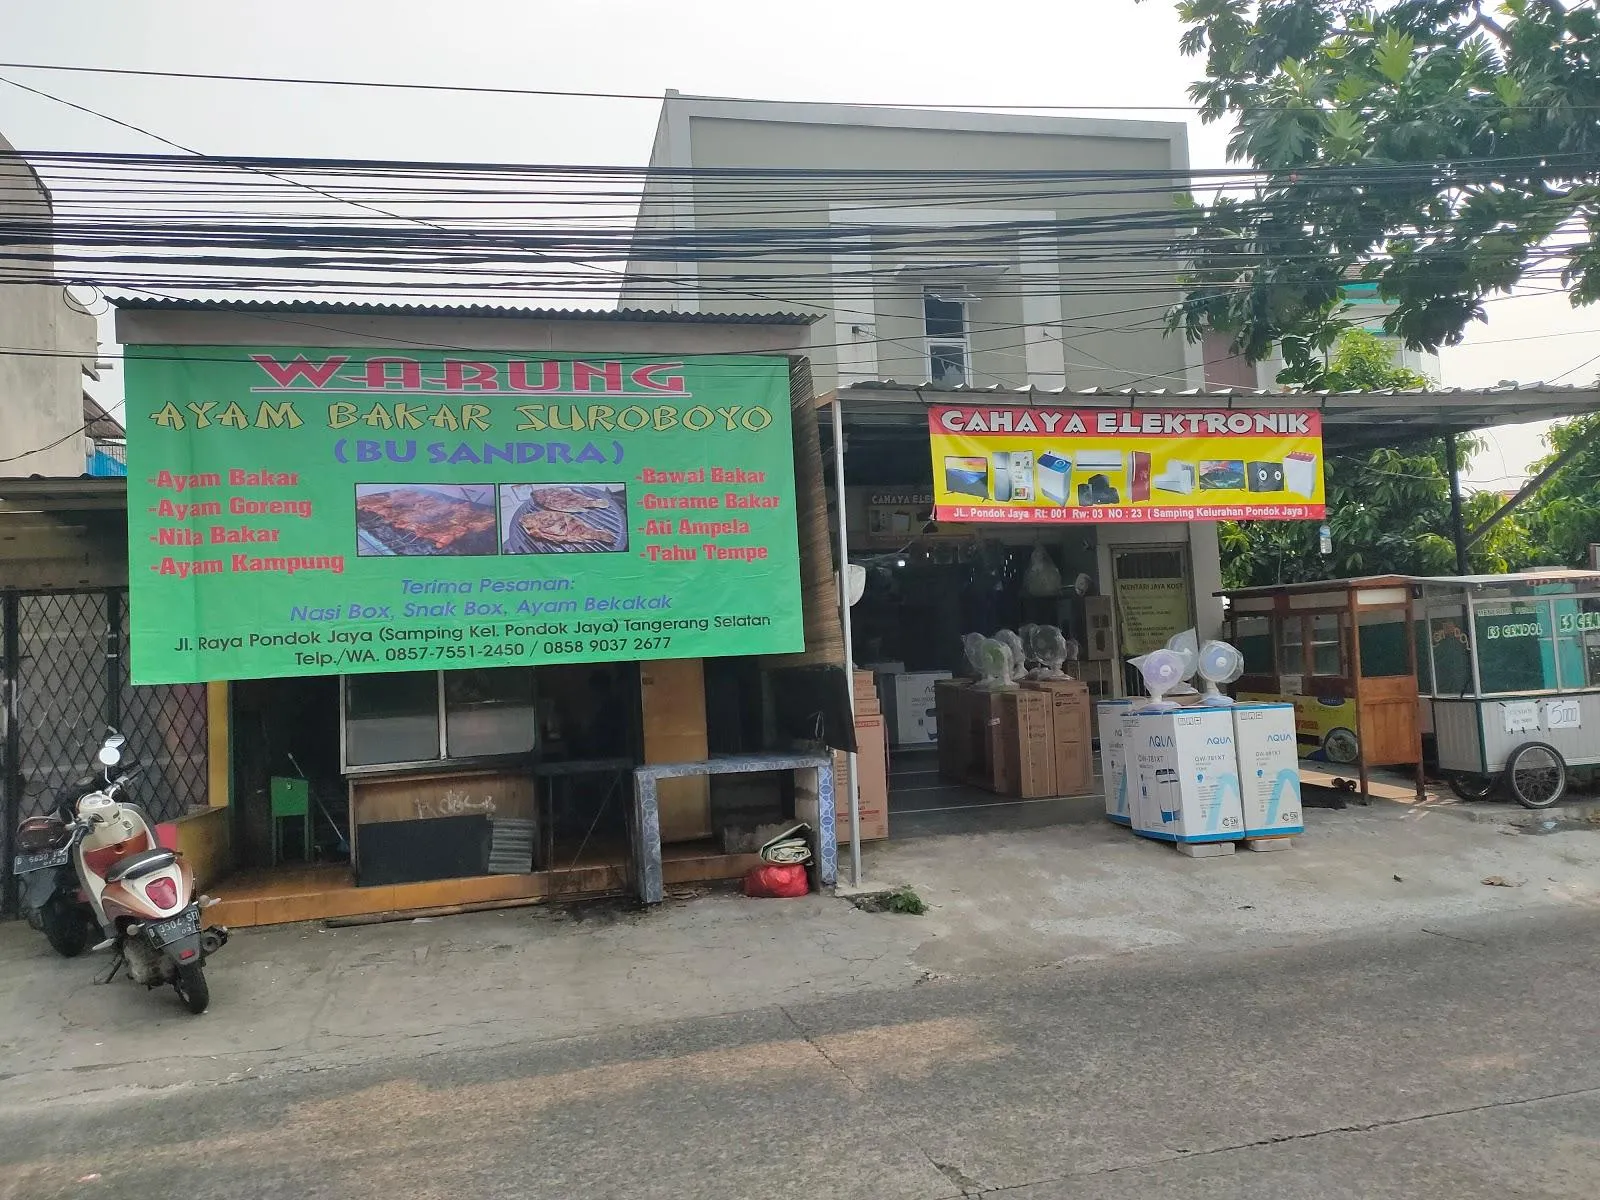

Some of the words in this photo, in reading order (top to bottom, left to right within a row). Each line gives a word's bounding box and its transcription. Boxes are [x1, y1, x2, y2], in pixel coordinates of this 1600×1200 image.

[249, 353, 686, 394] WARUNG
[149, 400, 305, 431] AYAM
[327, 402, 492, 432] BAKAR
[515, 404, 773, 432] SUROBOYO
[941, 409, 1088, 433] CAHAYA
[1096, 410, 1310, 434] ELEKTRONIK
[426, 440, 625, 465] SANDRA)
[229, 469, 299, 486] Bakar
[711, 467, 767, 483] Bakar
[229, 497, 312, 518] Goreng
[725, 492, 780, 508] Bakar
[954, 508, 968, 518] JL.
[971, 508, 1005, 518] Pondok
[1008, 508, 1029, 519] Jaya
[1051, 509, 1067, 518] 001
[1072, 509, 1089, 518] Rw:
[1092, 509, 1103, 518] 03
[1108, 509, 1123, 518] NO
[1131, 509, 1142, 518] 23
[1197, 507, 1243, 517] Kelurahan
[1246, 507, 1280, 516] Pondok
[210, 526, 280, 544] Bakar
[679, 519, 750, 538] Ampela
[703, 544, 768, 563] Tempe
[231, 554, 345, 574] Kampung
[402, 579, 472, 595] Terima
[480, 579, 575, 593] Pesanan:
[290, 604, 341, 621] Nasi
[348, 603, 394, 620] Box,
[403, 602, 456, 618] Snak
[516, 599, 577, 617] Ayam
[584, 596, 673, 612] Bekakak
[174, 637, 192, 652] Jl.
[199, 635, 243, 652] Raya
[250, 631, 321, 648] Pondok
[327, 630, 373, 645] Jaya
[379, 625, 463, 642] (Samping
[469, 624, 500, 638] Kel.
[505, 621, 568, 637] Pondok
[573, 619, 618, 635] Jaya)
[624, 616, 709, 633] Tangerang
[714, 614, 771, 629] Selatan
[1487, 625, 1500, 639] ES
[1502, 622, 1543, 638] CENDOL
[385, 642, 524, 662] 0857-7551-2450
[543, 640, 583, 654] 0858
[590, 638, 627, 652] 9037
[633, 636, 672, 650] 2677
[1149, 735, 1174, 748] AQUA
[1206, 736, 1232, 746] AQUA
[1267, 734, 1293, 743] AQUA
